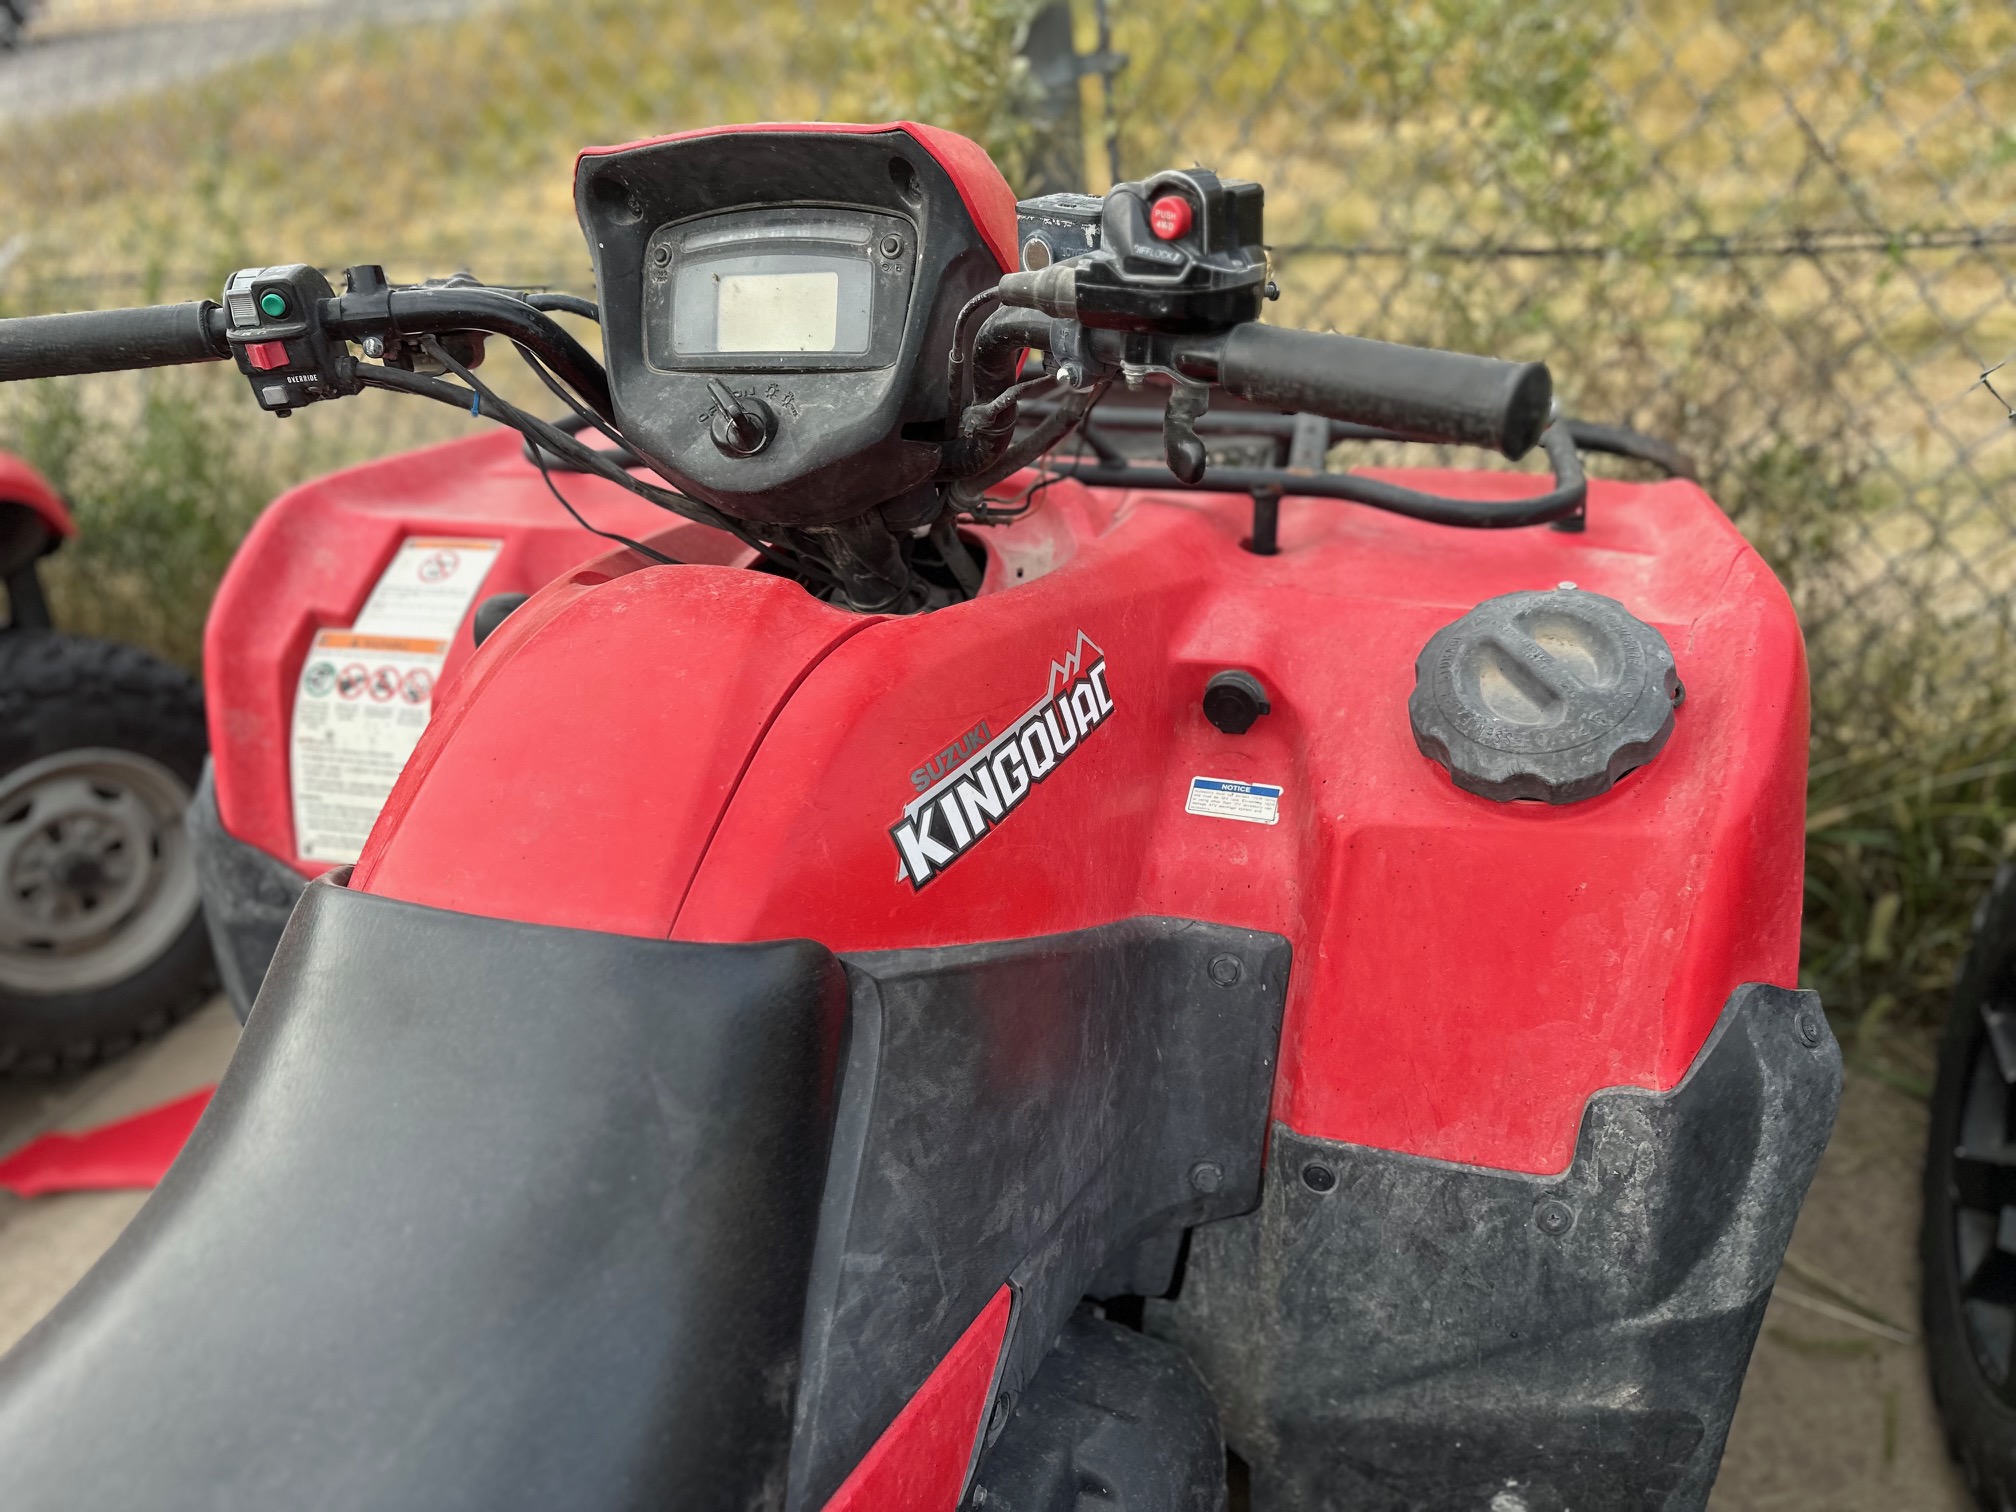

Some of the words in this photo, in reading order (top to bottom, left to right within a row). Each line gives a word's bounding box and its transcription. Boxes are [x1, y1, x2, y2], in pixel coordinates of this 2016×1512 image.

[1155, 209, 1177, 220] PUSH
[1156, 221, 1175, 231] 4WD
[286, 374, 319, 384] OVERRIDE
[910, 720, 993, 793] SUZUKI
[1221, 784, 1251, 793] NOTICE
